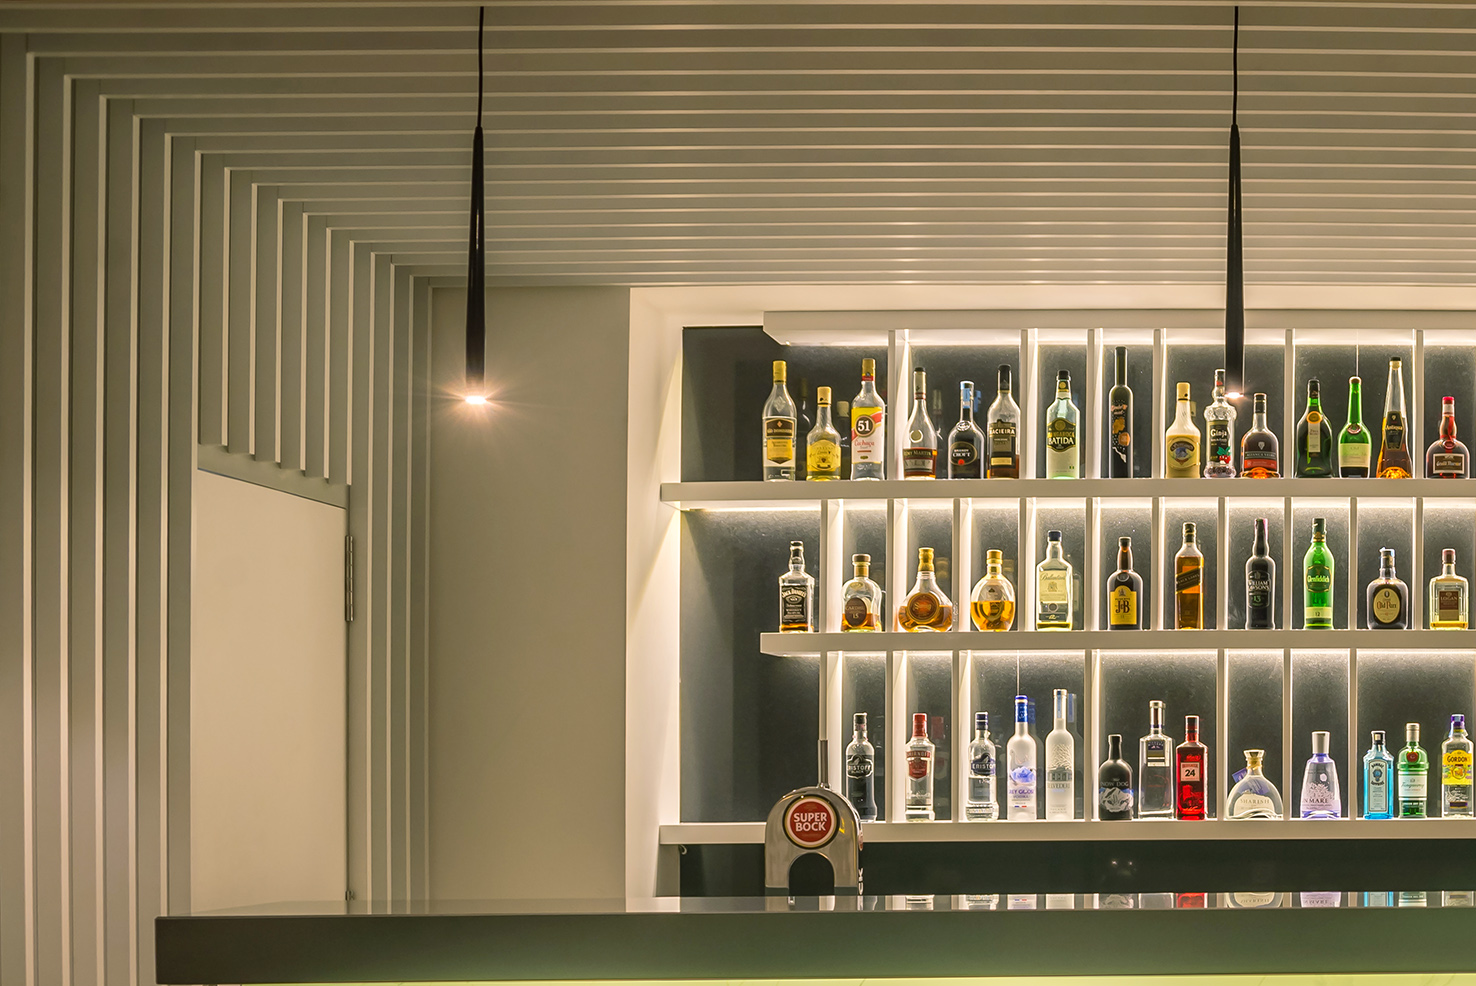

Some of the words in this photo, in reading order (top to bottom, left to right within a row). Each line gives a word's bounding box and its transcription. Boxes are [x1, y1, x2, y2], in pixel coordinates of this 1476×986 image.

[858, 419, 871, 432] 51
[1048, 436, 1075, 445] BATIDA
[1184, 768, 1196, 777] 24
[793, 811, 829, 823] SUPER
[795, 821, 827, 833] BOCK
